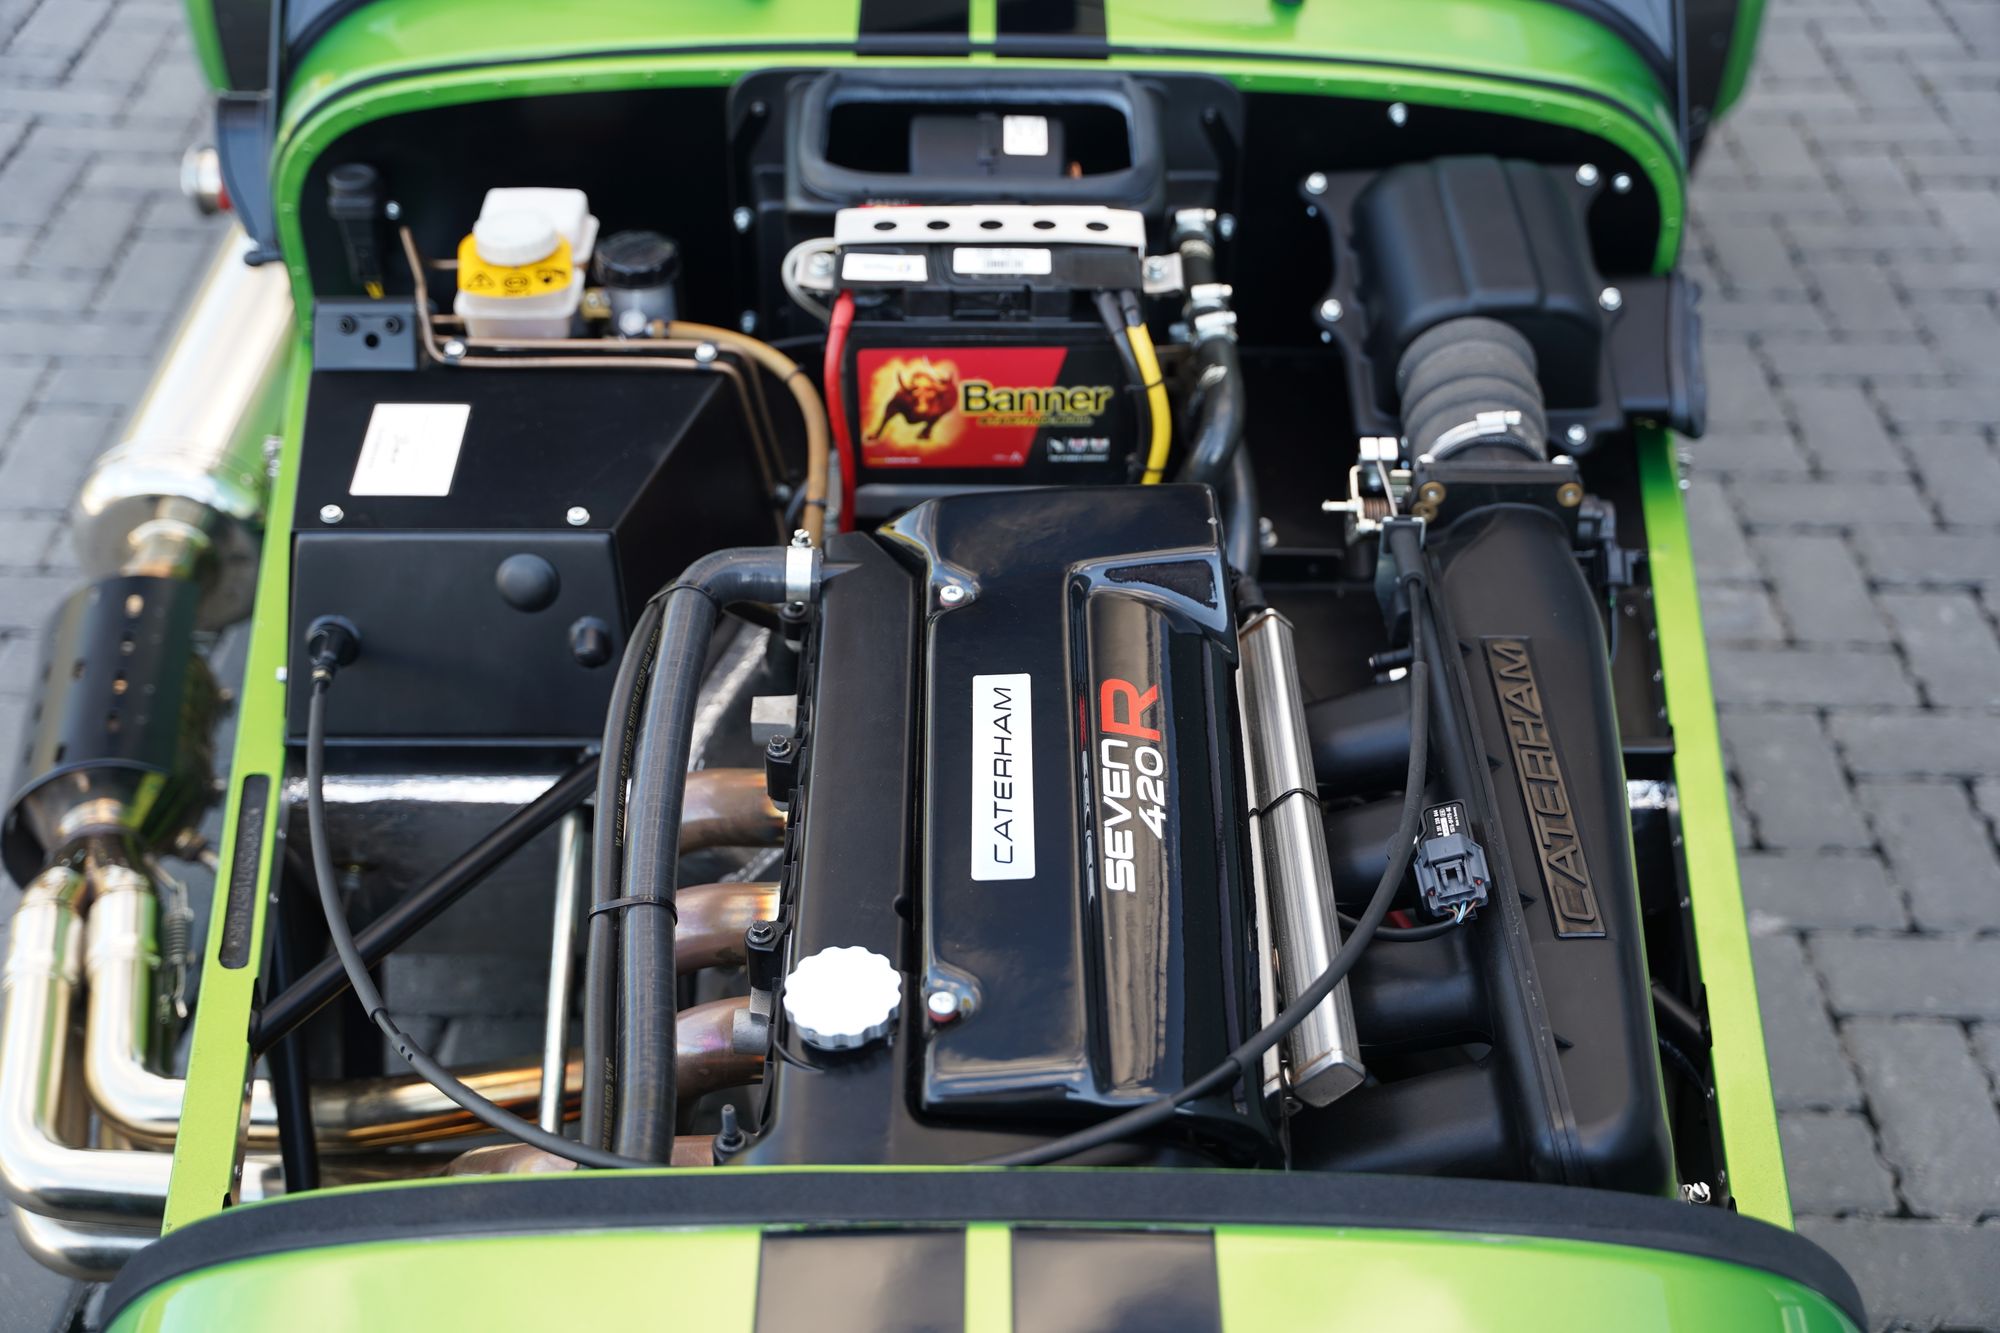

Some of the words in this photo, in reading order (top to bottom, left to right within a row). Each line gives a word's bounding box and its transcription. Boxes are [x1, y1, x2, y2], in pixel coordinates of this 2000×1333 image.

[961, 382, 1109, 415] Banner
[993, 687, 1013, 864] CATERHAM
[1134, 745, 1167, 840] 420
[1492, 642, 1596, 923] CATERHAM
